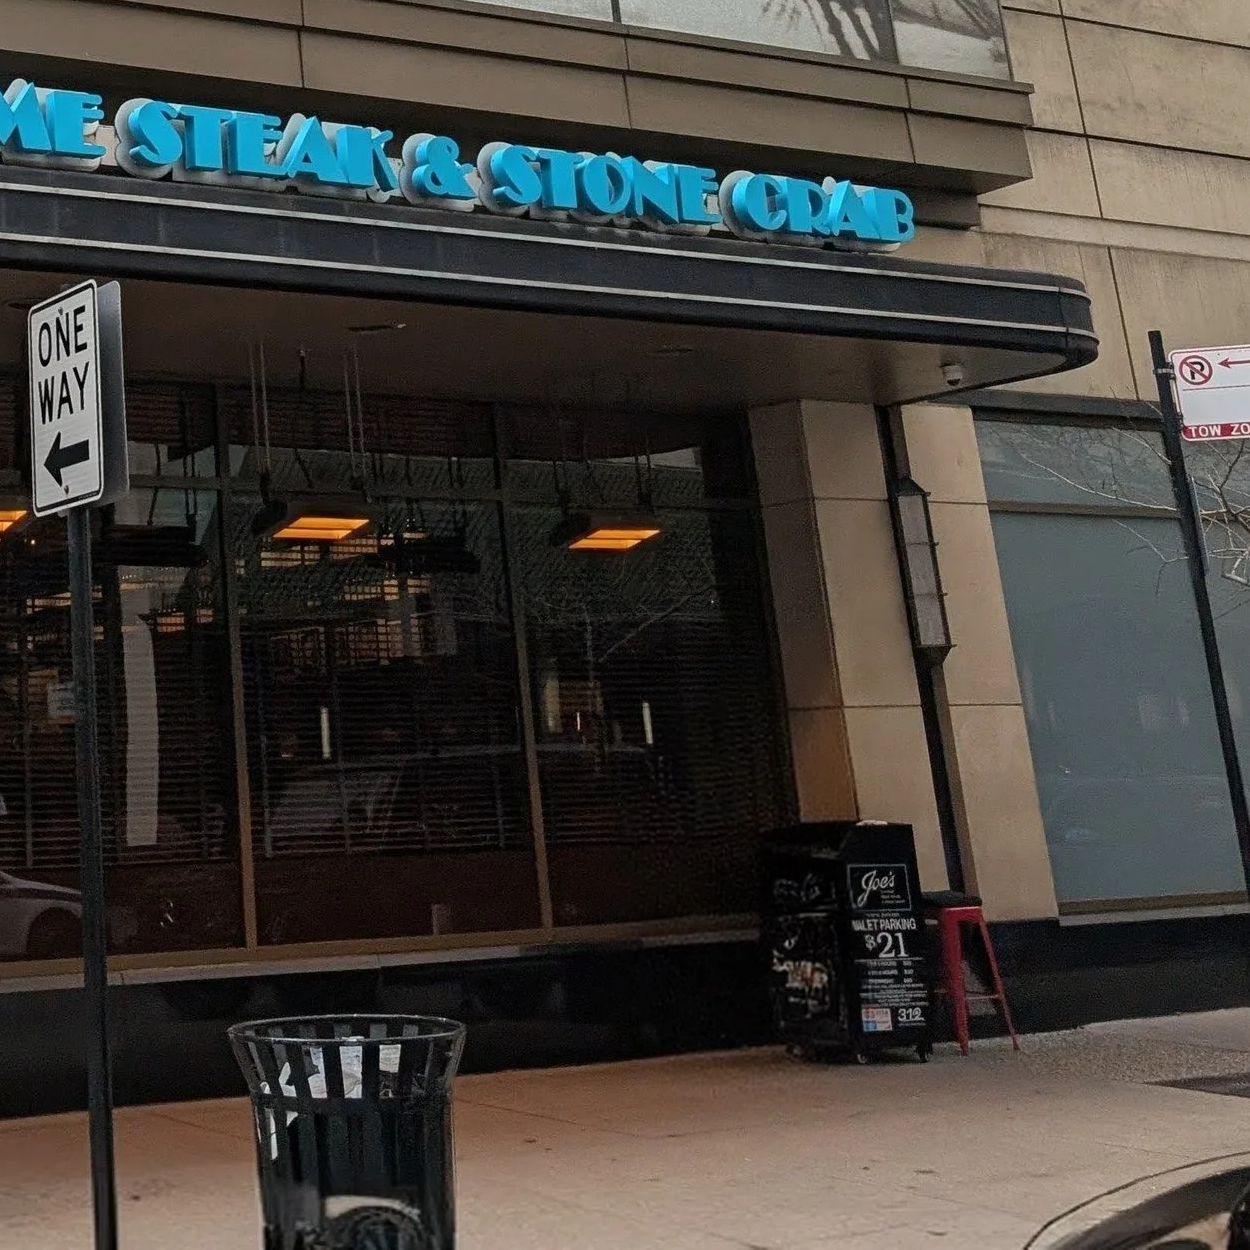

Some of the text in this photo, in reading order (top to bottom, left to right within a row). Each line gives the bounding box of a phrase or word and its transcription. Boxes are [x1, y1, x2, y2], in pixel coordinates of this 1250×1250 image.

[128, 99, 396, 193] STEAK
[411, 135, 480, 202] &
[491, 144, 724, 227] STONE
[731, 171, 916, 244] CRAB
[38, 305, 88, 367] ONE
[38, 361, 90, 424] WAY
[1188, 425, 1221, 438] TOW
[857, 869, 896, 907] Joe's
[851, 917, 917, 931] VALET PARKING
[864, 932, 910, 958] $21
